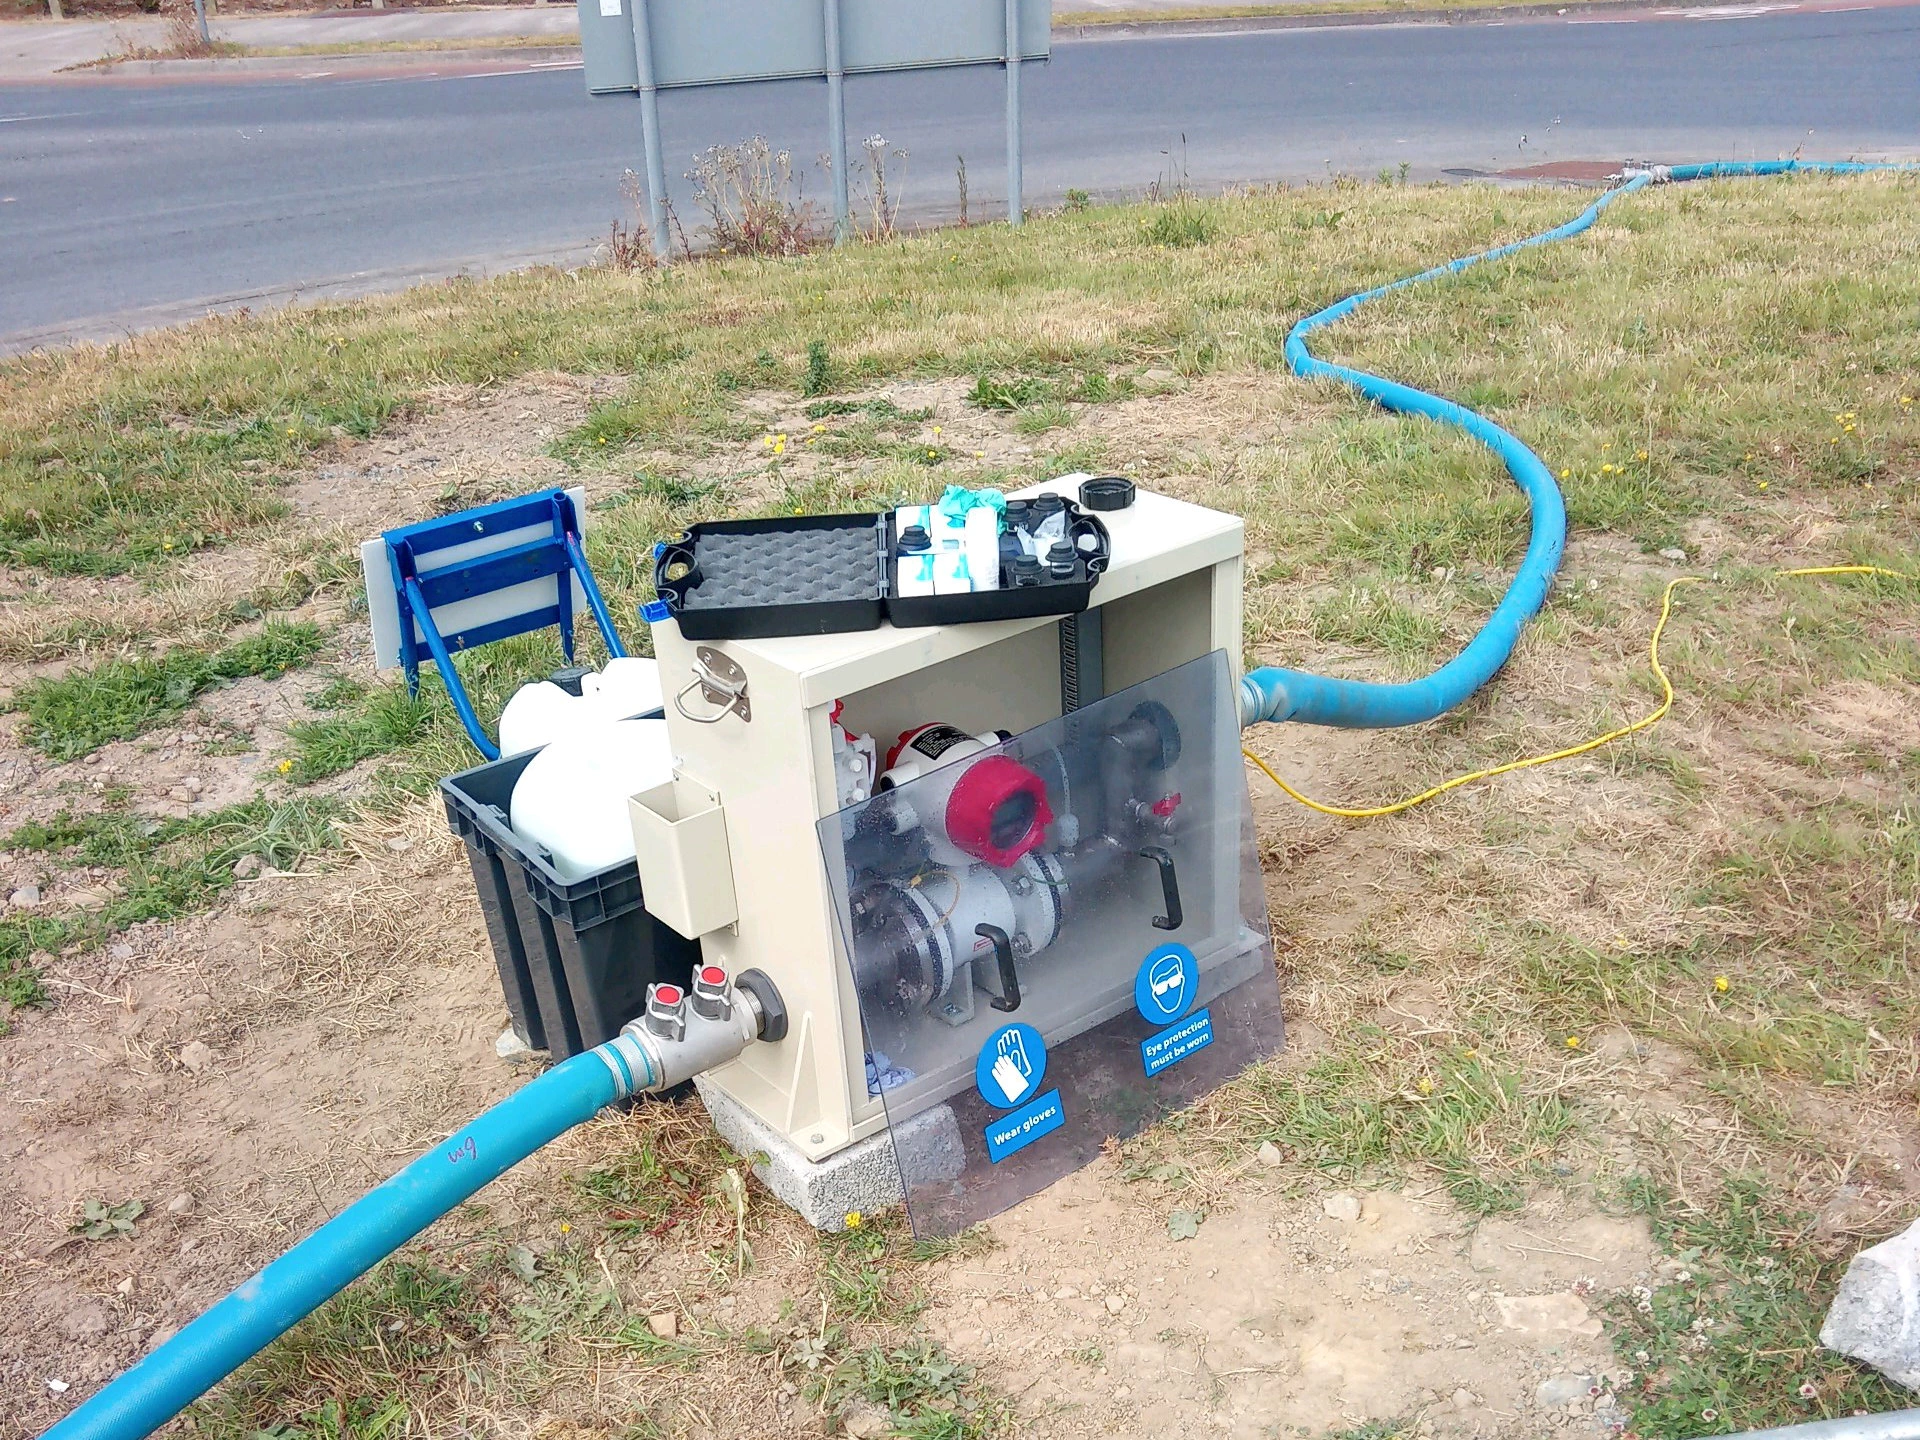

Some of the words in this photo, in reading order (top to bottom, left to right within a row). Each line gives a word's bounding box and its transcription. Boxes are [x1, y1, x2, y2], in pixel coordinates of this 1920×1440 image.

[1146, 1043, 1162, 1056] Eye
[1163, 1018, 1209, 1050] protection
[1151, 1051, 1173, 1069] must
[1174, 1045, 1185, 1057] be
[1187, 1033, 1209, 1049] worn
[994, 1125, 1021, 1145] Wear
[1022, 1106, 1056, 1132] gloves
